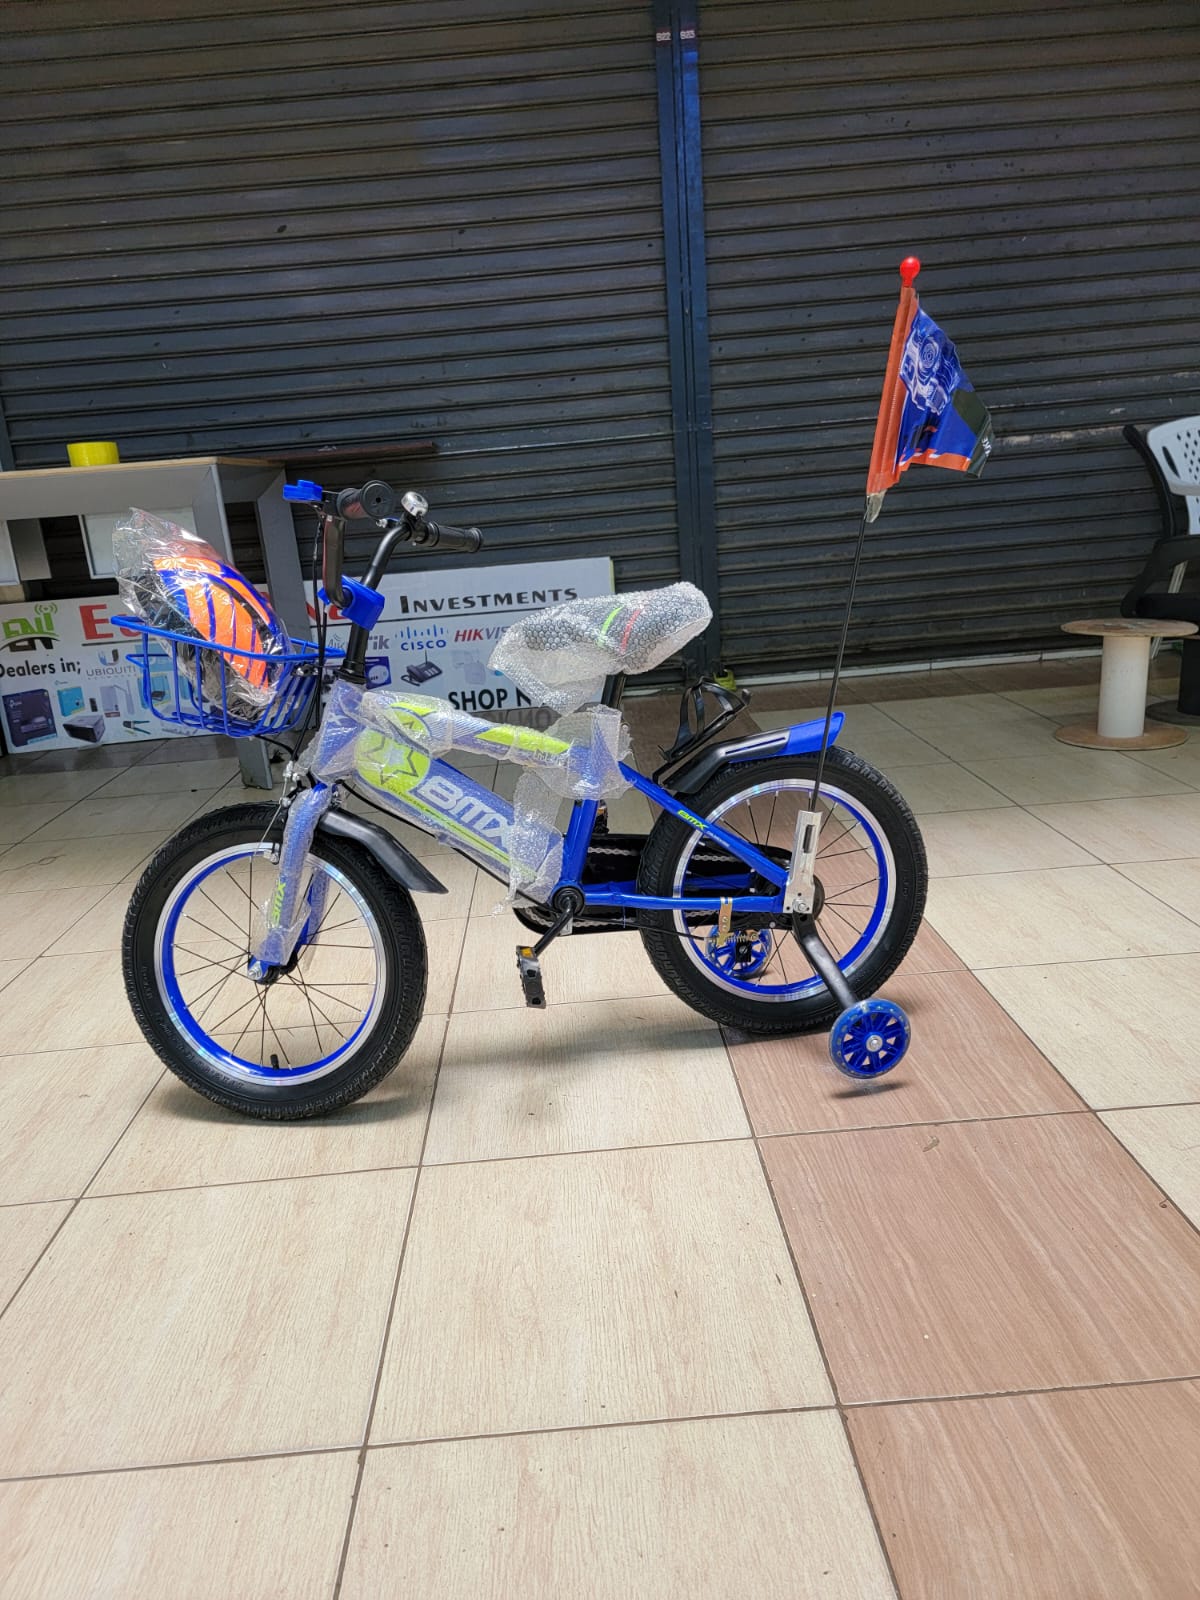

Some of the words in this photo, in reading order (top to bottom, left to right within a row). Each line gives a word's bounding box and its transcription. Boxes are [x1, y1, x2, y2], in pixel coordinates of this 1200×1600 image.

[400, 588, 578, 614] INVESTMENTS
[400, 639, 447, 651] CISCO
[60, 657, 81, 675] in;
[86, 665, 136, 677] UBIQUITI
[448, 688, 508, 711] SHOP
